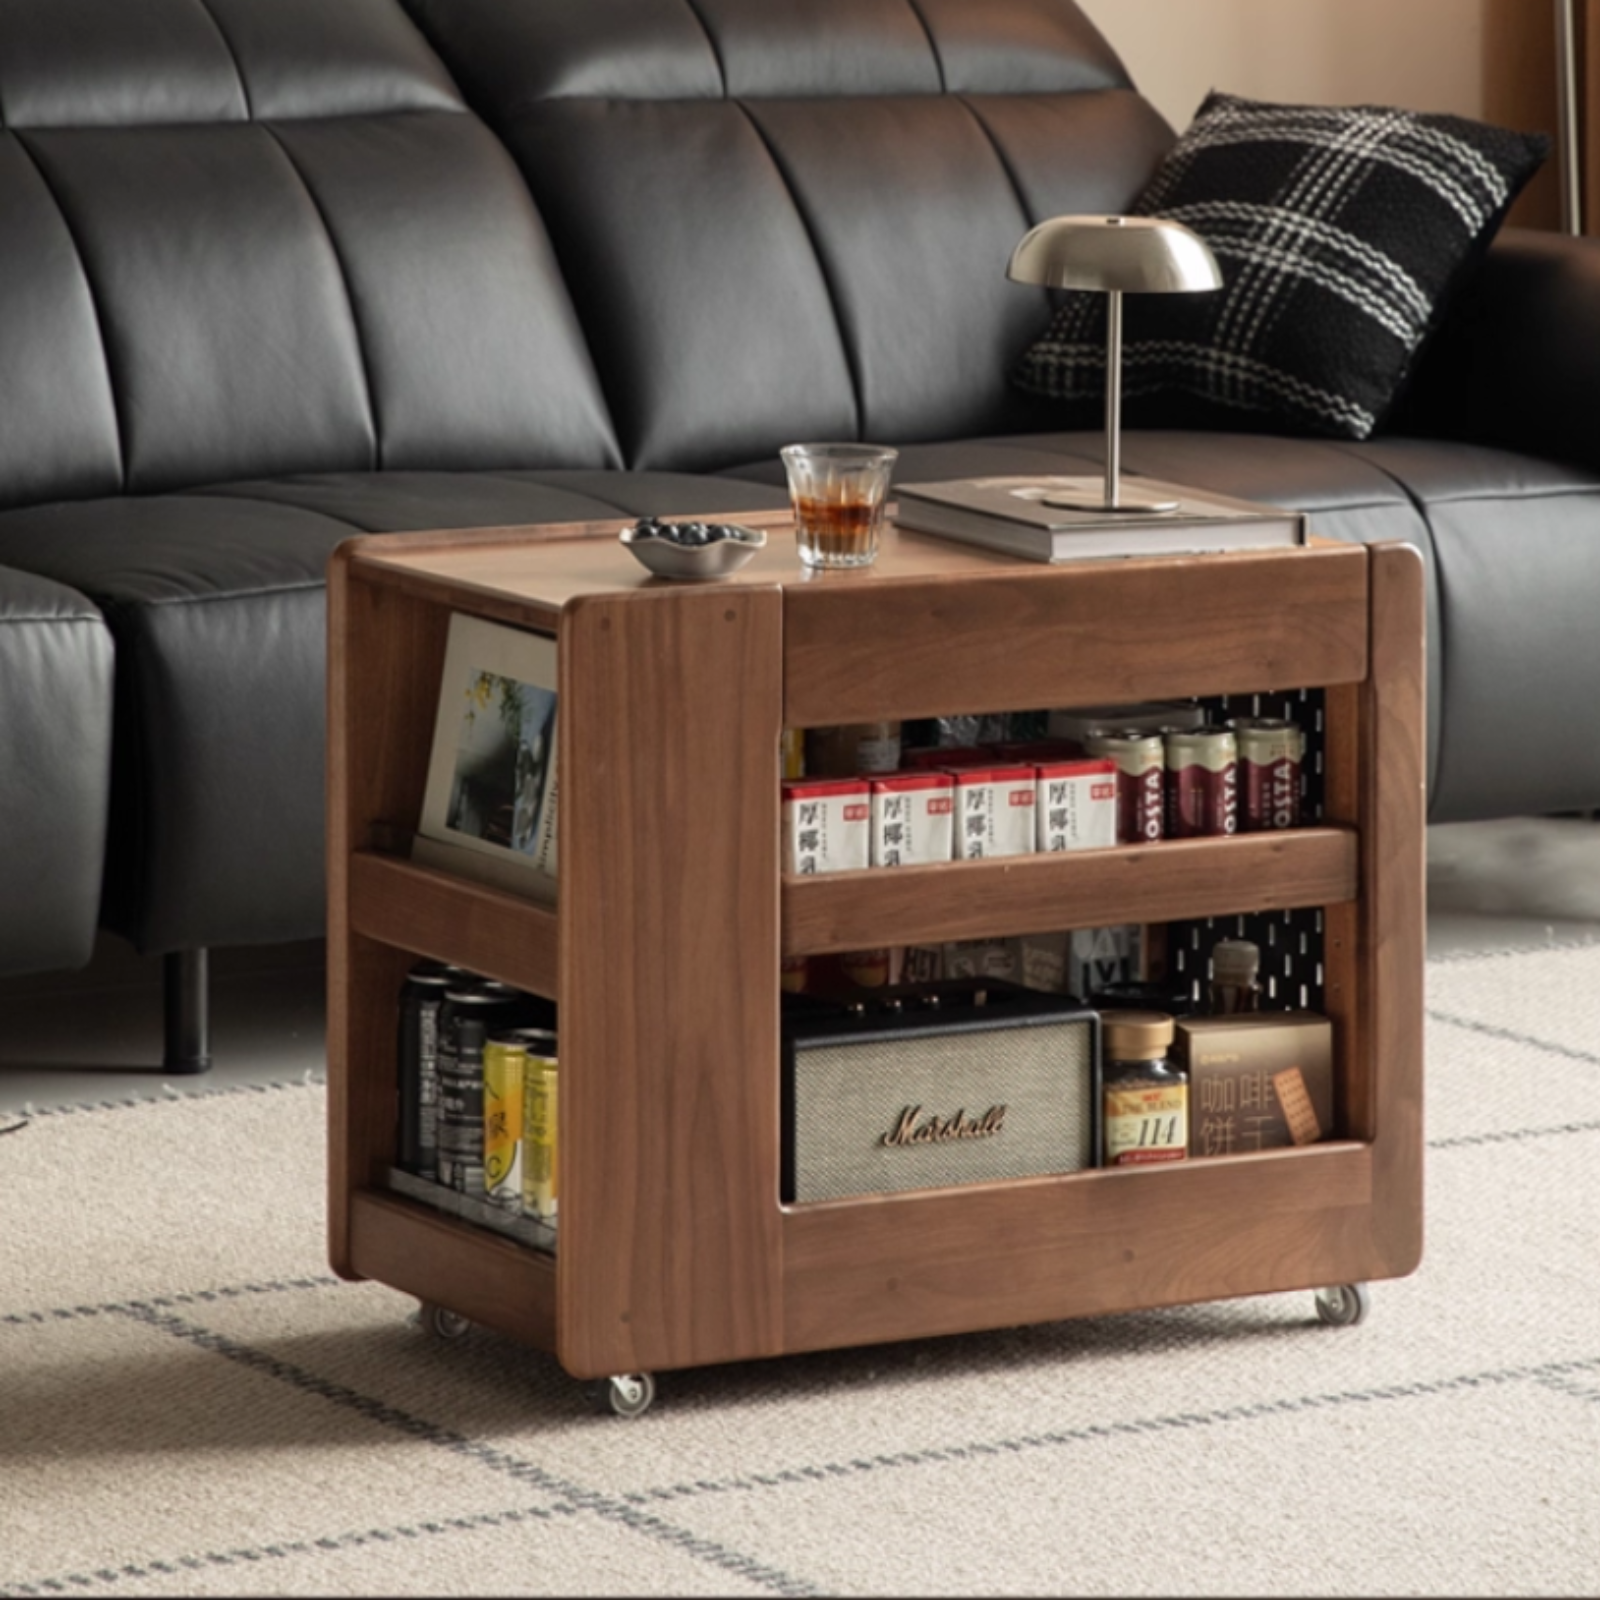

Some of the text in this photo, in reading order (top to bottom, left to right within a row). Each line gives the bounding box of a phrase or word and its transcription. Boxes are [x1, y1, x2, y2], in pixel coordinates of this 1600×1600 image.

[1145, 771, 1160, 843] OSTA
[1223, 766, 1237, 837] OSTA
[1273, 762, 1293, 829] OSTA
[1199, 1072, 1273, 1112] 咖啡
[880, 1103, 1008, 1148] Marshall
[1138, 1115, 1177, 1147] 114
[1198, 1114, 1277, 1157] 饼干
